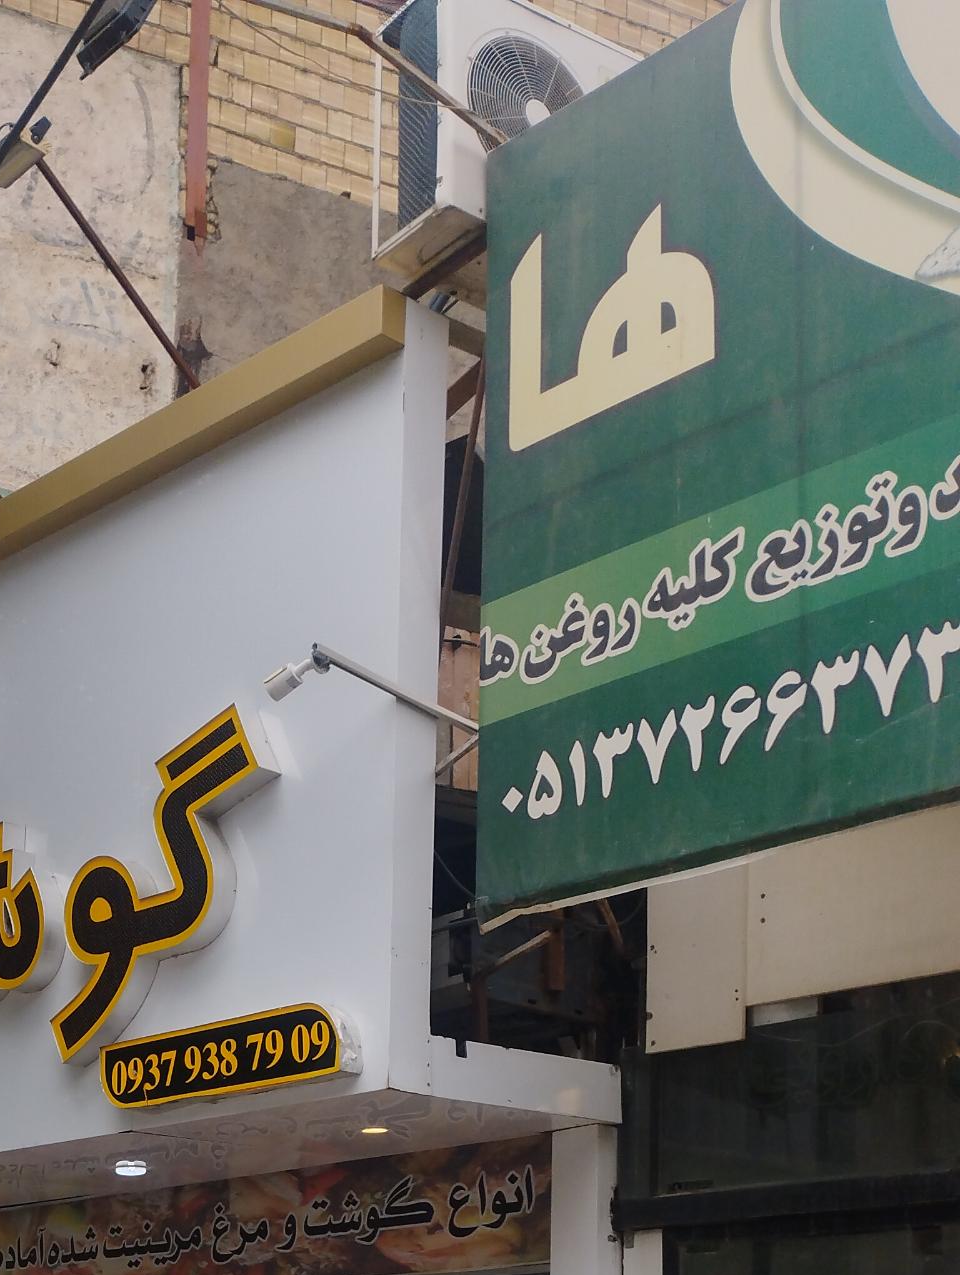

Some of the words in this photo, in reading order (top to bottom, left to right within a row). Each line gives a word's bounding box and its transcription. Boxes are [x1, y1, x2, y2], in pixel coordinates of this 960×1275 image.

[509, 204, 716, 451] ها
[643, 526, 745, 630] کلیه
[519, 592, 642, 684] روغن
[111, 1050, 177, 1096] 0937
[183, 1038, 239, 1084] 938
[245, 1029, 284, 1072] 79
[290, 1020, 331, 1063] 09
[211, 1203, 269, 1264] مرغ
[275, 1213, 298, 1251] و
[302, 1175, 435, 1245] گوشت
[447, 1164, 534, 1239] انواع
[47, 1225, 98, 1266] شده
[103, 1220, 202, 1269] مرینیت
